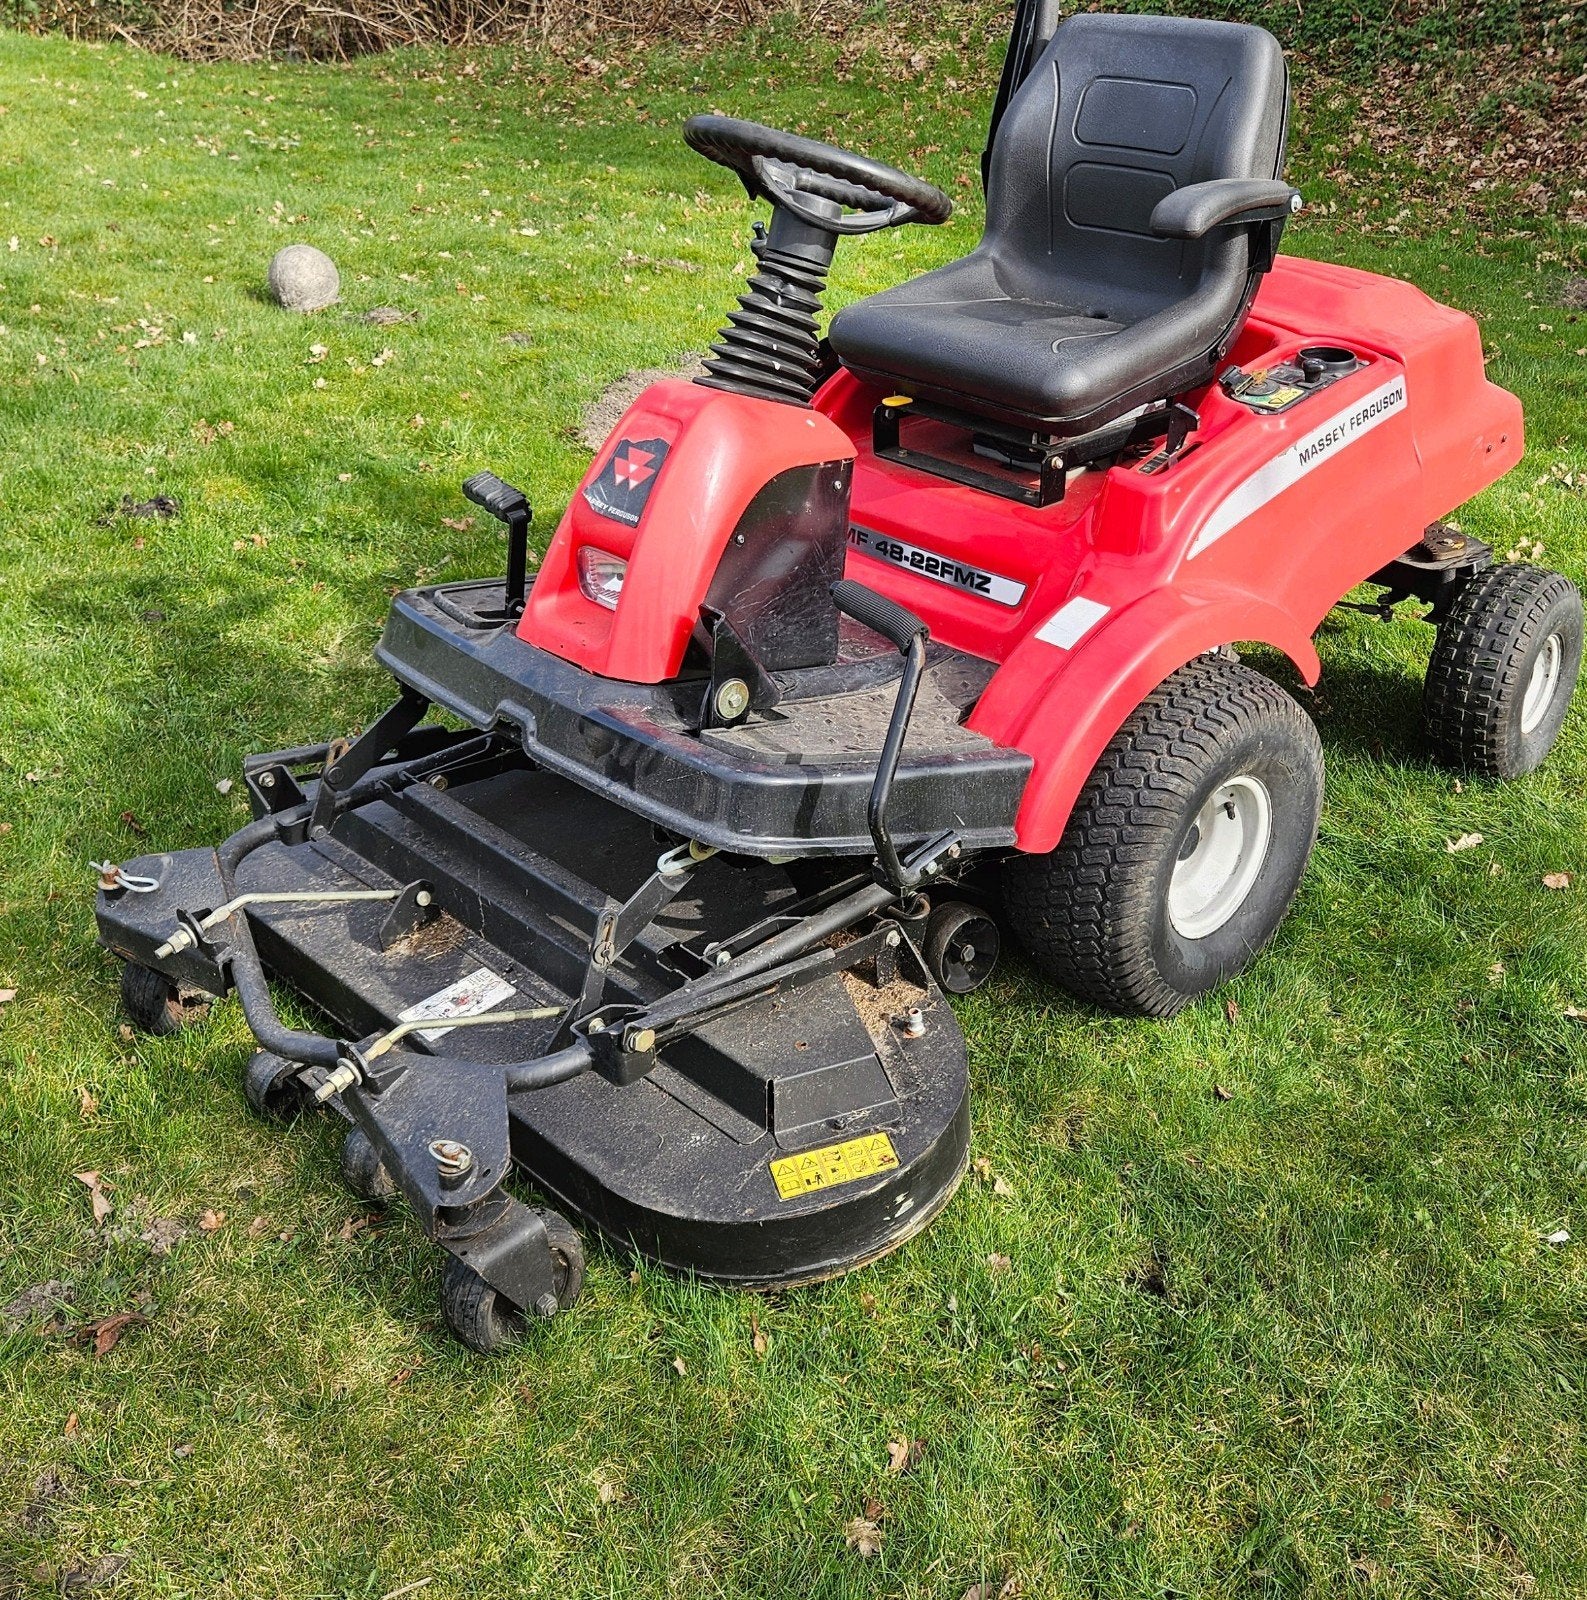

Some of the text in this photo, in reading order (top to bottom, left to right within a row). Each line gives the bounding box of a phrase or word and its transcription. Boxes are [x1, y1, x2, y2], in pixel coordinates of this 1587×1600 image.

[1299, 422, 1346, 466] MASSEY
[1350, 387, 1403, 431] FERGUSON
[608, 505, 639, 523] FERGUSON
[875, 540, 992, 594] 48-22FMZ
